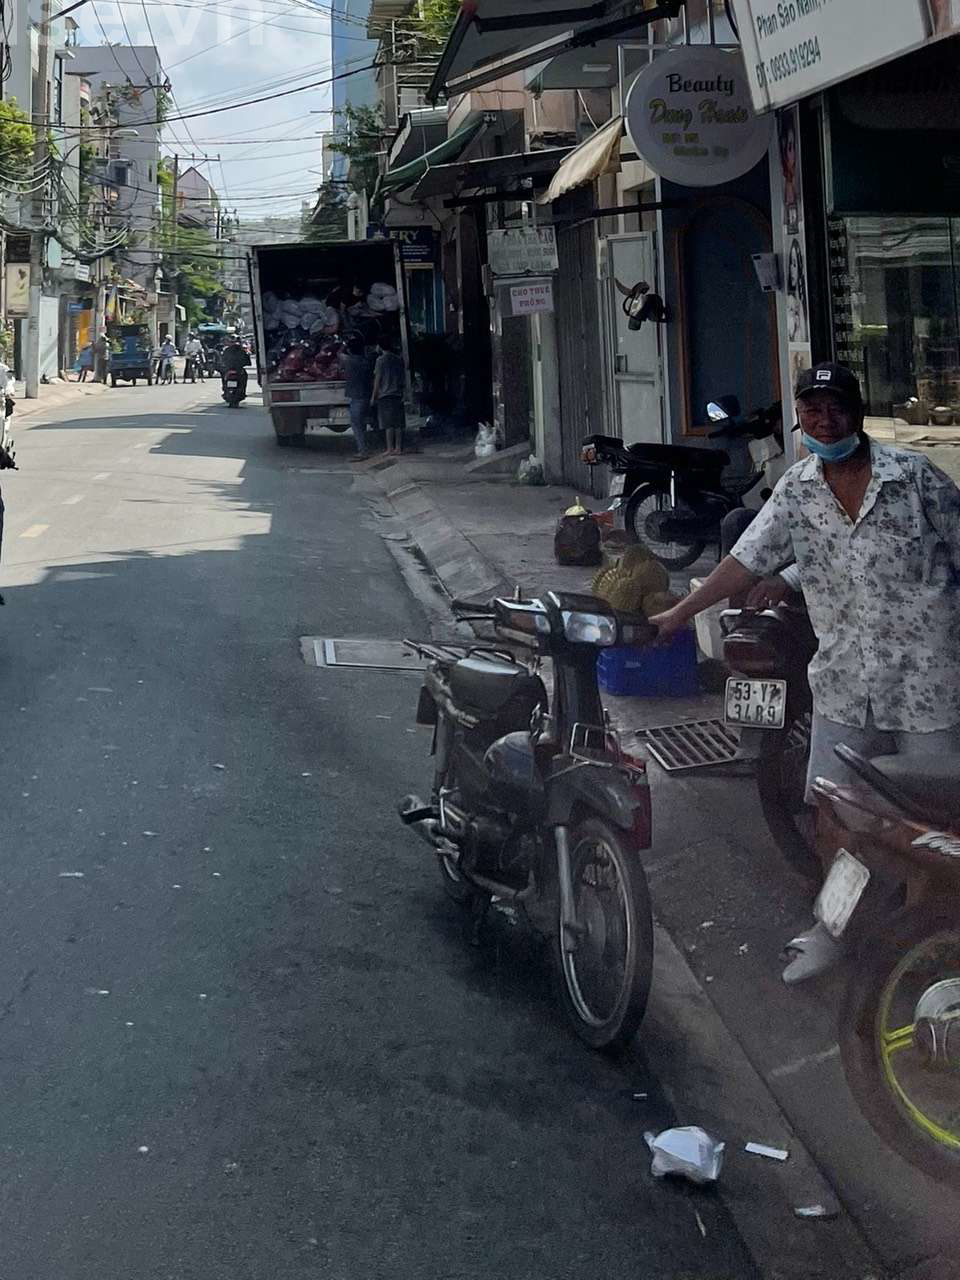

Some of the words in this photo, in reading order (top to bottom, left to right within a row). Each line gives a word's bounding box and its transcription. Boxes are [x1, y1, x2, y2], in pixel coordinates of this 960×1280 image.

[756, 13, 778, 39] Phan
[777, 0, 796, 27] Sào
[665, 73, 735, 97] Beauty
[512, 287, 528, 297] CHO
